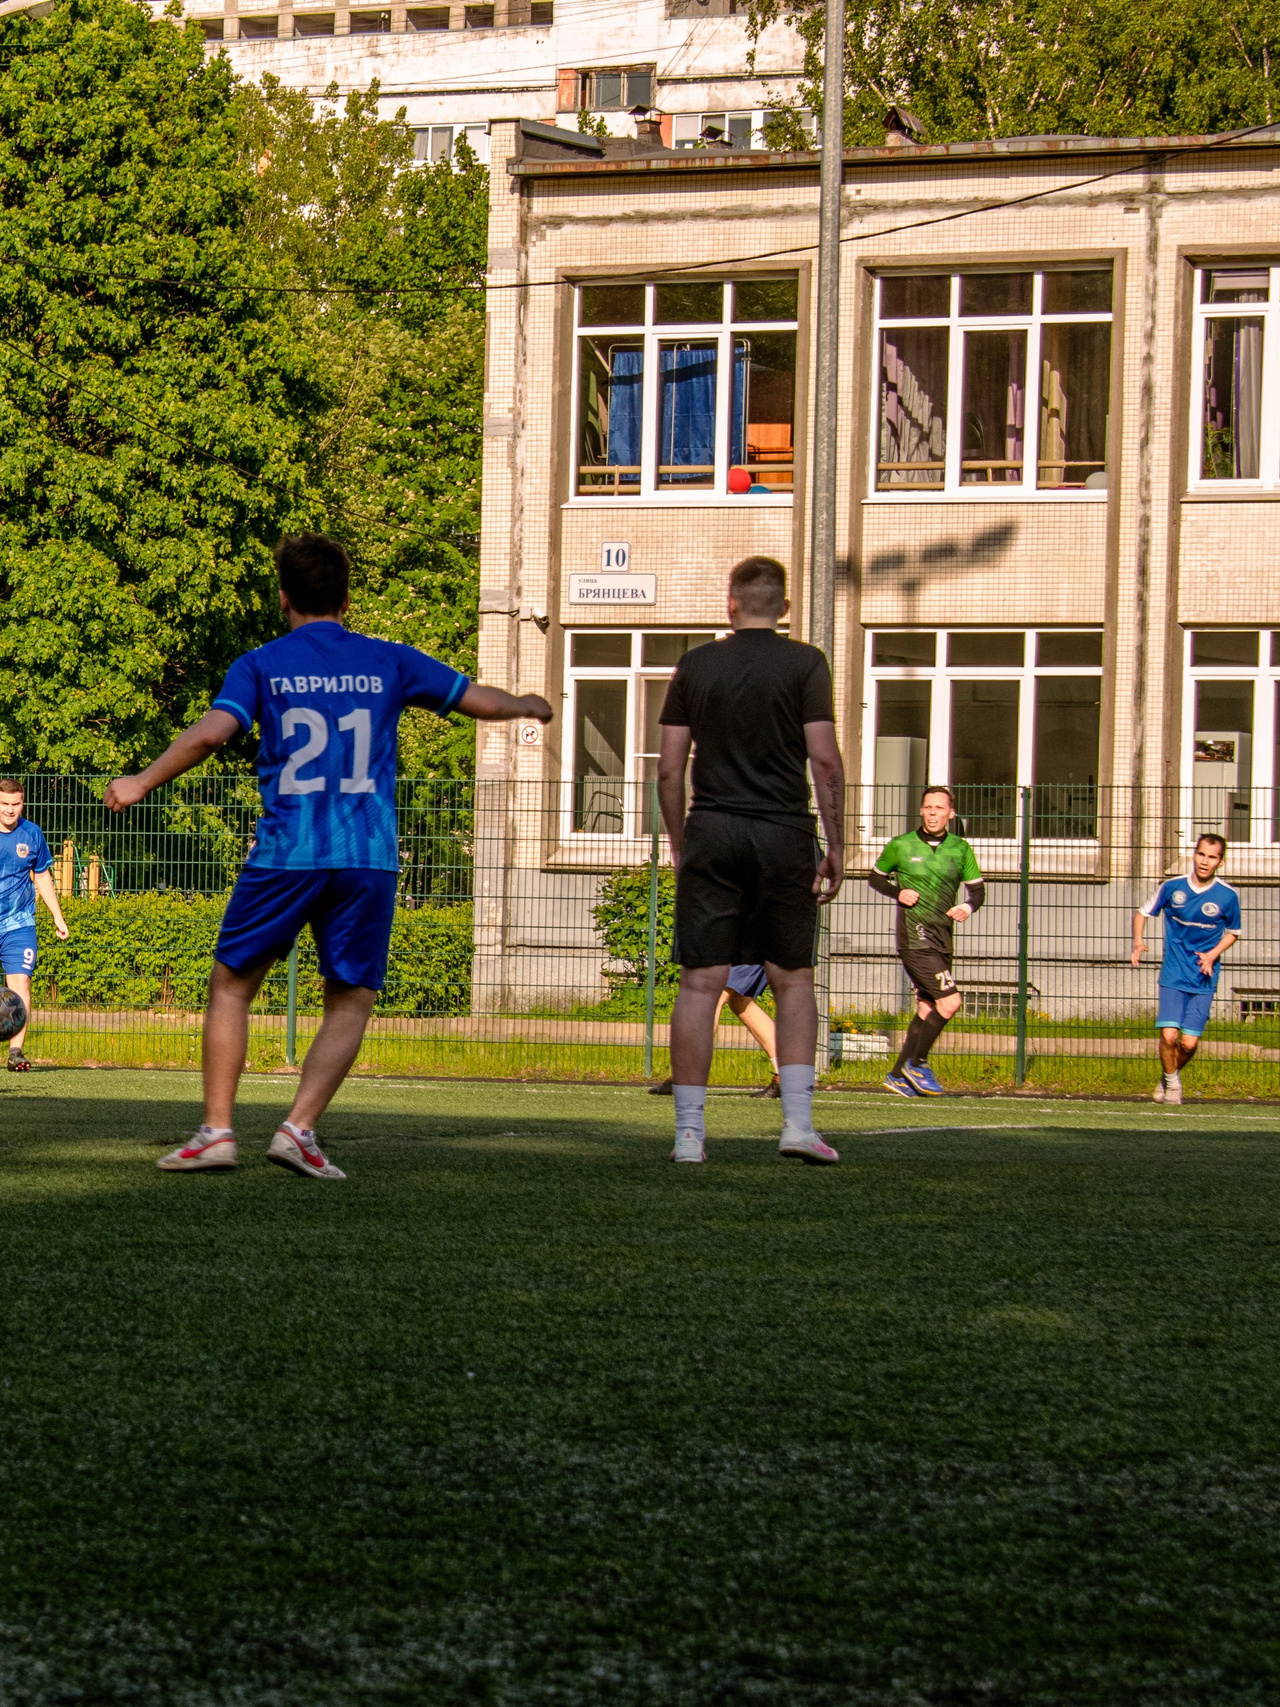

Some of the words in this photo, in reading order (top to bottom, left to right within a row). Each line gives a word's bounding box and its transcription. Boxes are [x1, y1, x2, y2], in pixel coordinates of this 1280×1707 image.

[604, 548, 626, 567] 10
[578, 588, 647, 600] БРЯНЦЕВА
[269, 674, 384, 696] ГАВРИЛОВ
[278, 707, 376, 795] 21
[23, 948, 34, 964] 9
